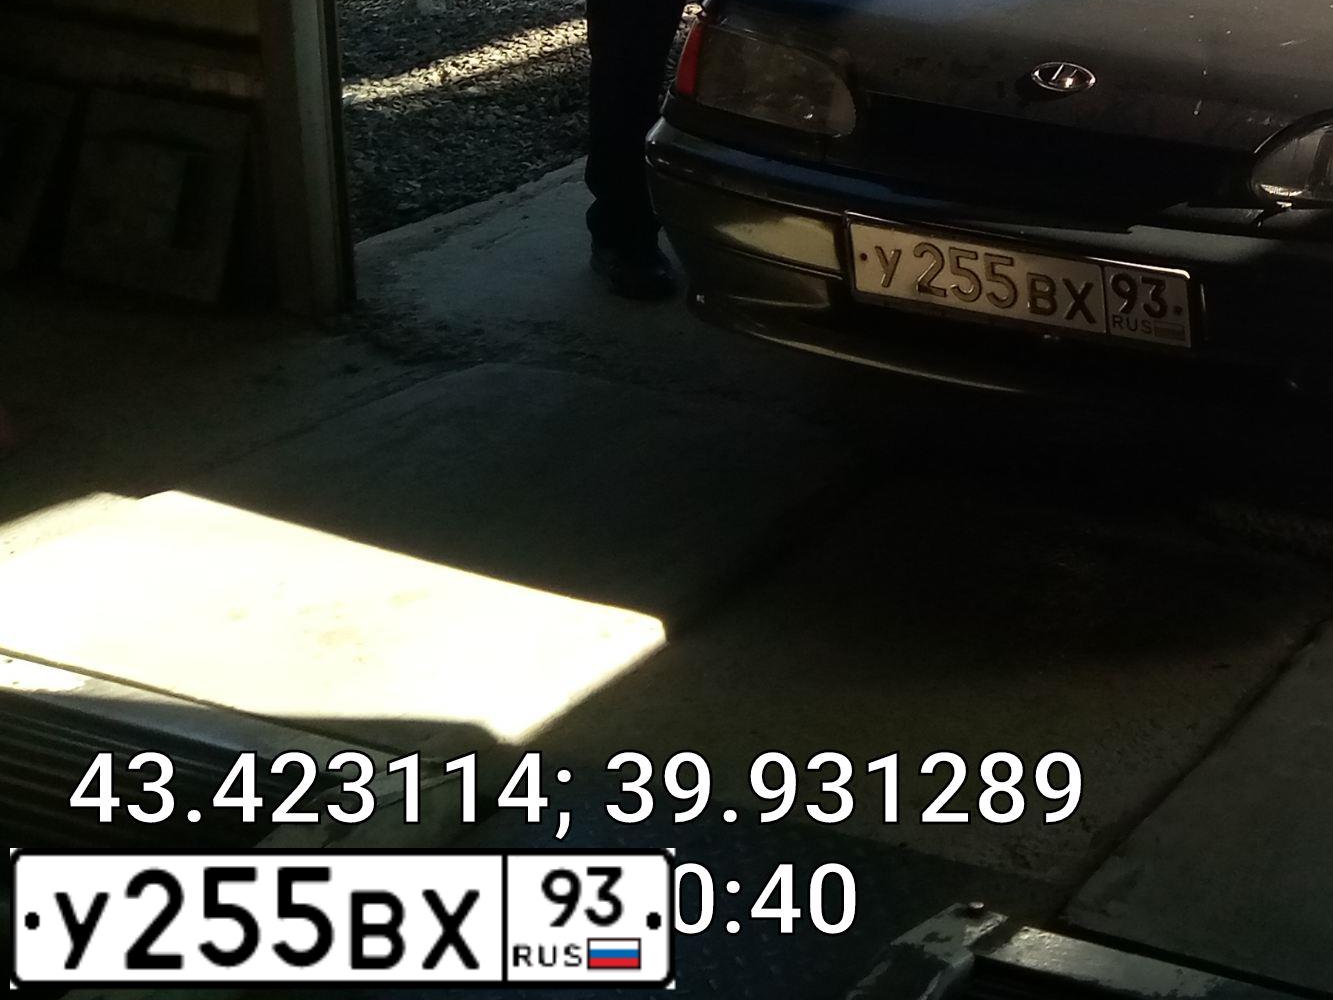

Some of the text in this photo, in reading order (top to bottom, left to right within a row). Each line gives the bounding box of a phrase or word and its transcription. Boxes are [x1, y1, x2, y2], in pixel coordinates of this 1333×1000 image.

[874, 242, 1168, 324] У255ВХ 93
[1111, 313, 1151, 334] RUS
